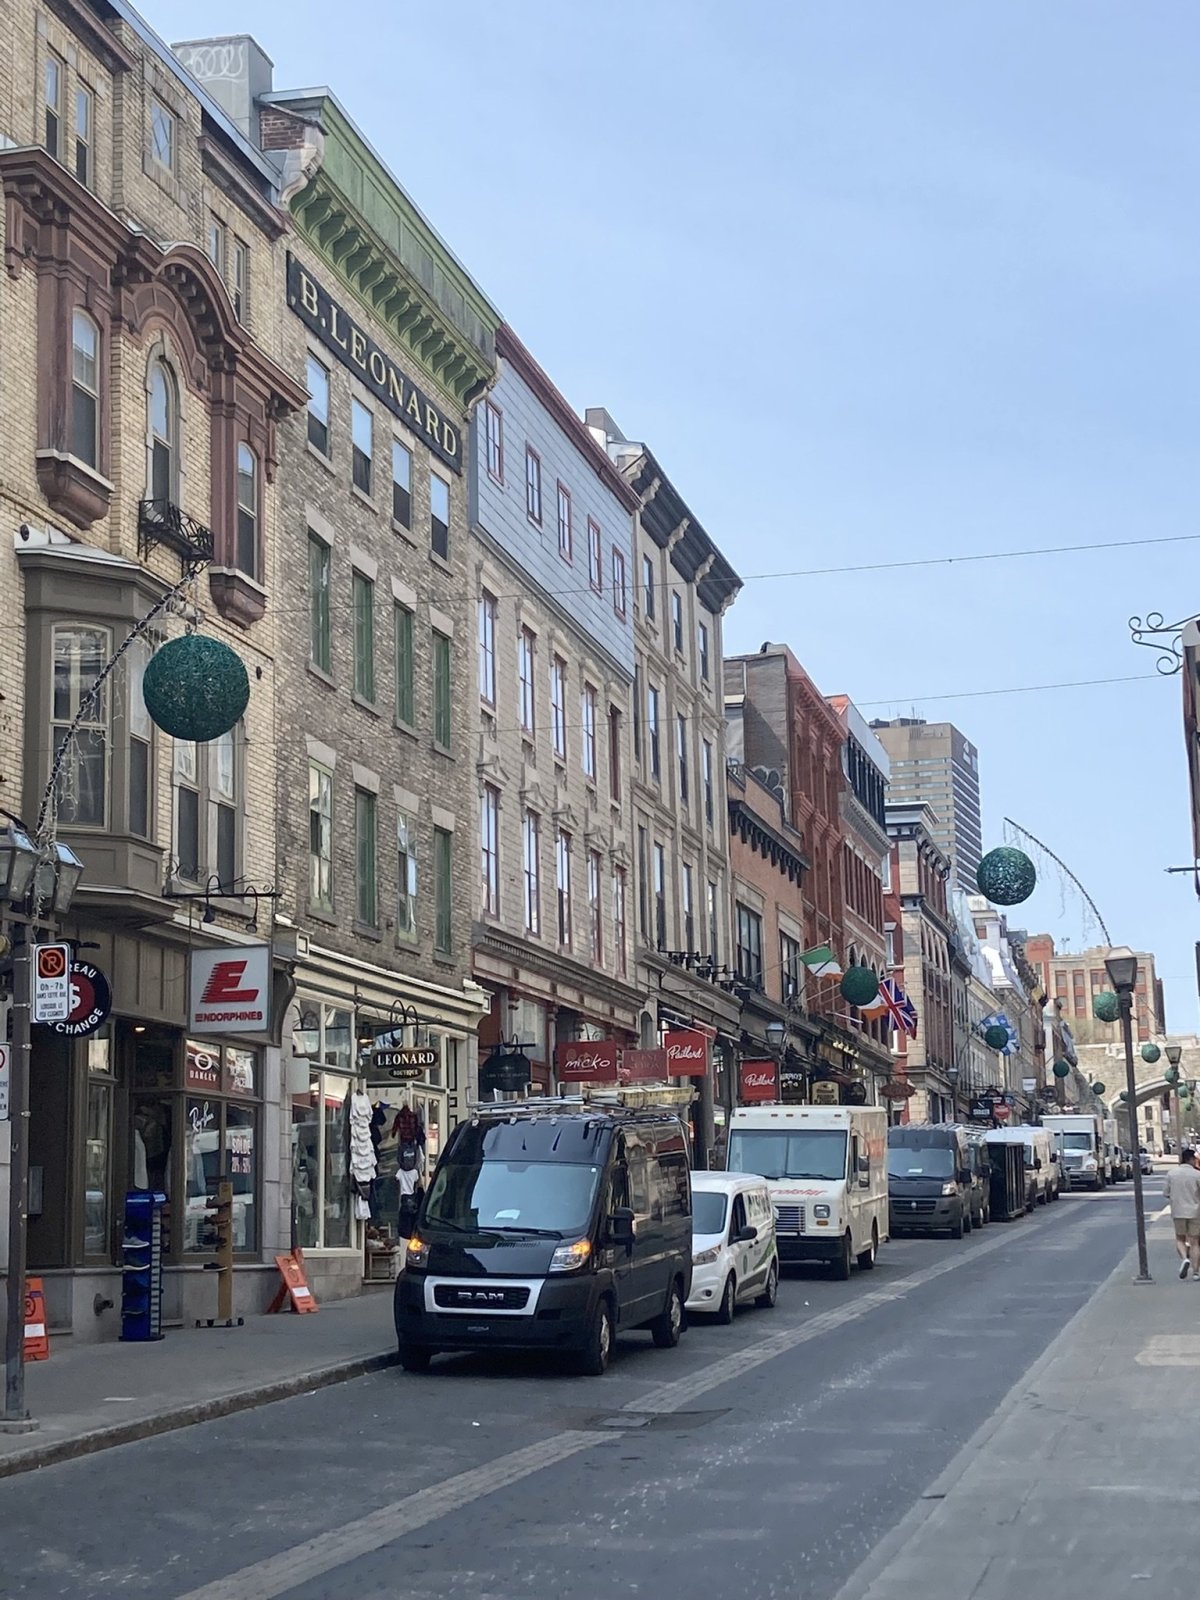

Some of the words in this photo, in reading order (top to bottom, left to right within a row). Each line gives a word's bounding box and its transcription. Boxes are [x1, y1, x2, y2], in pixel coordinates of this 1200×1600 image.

[55, 1008, 103, 1034] CHANGE
[377, 1052, 435, 1066] LEONARD
[189, 1070, 217, 1082] OAKLEY
[392, 1069, 419, 1077] BOUTIQUE
[457, 1291, 505, 1301] RAM
